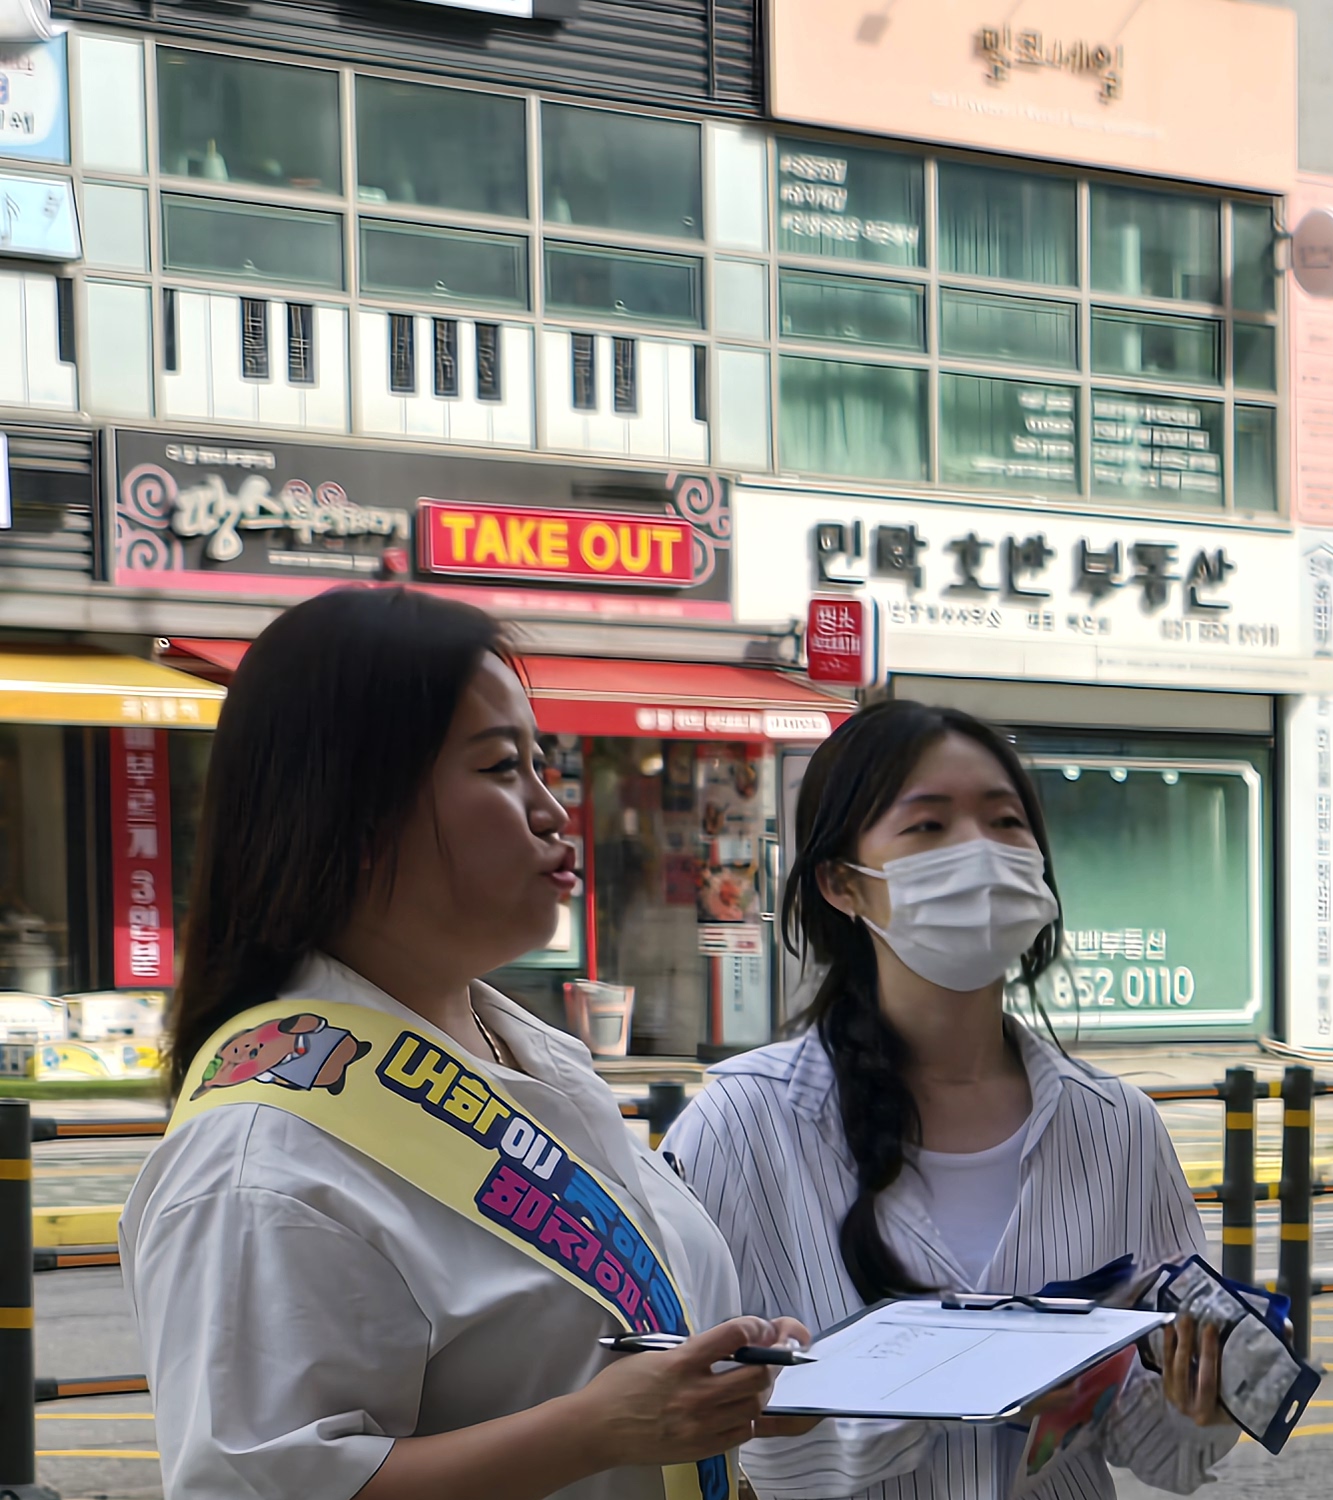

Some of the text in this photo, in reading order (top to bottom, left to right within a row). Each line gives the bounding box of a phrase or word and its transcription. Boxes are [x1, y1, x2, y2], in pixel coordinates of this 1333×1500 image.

[440, 514, 569, 570] TAKE
[578, 521, 684, 575] OUT
[944, 530, 1057, 600] 호반
[1074, 536, 1237, 613] 부동산
[1122, 965, 1195, 1007] 0110
